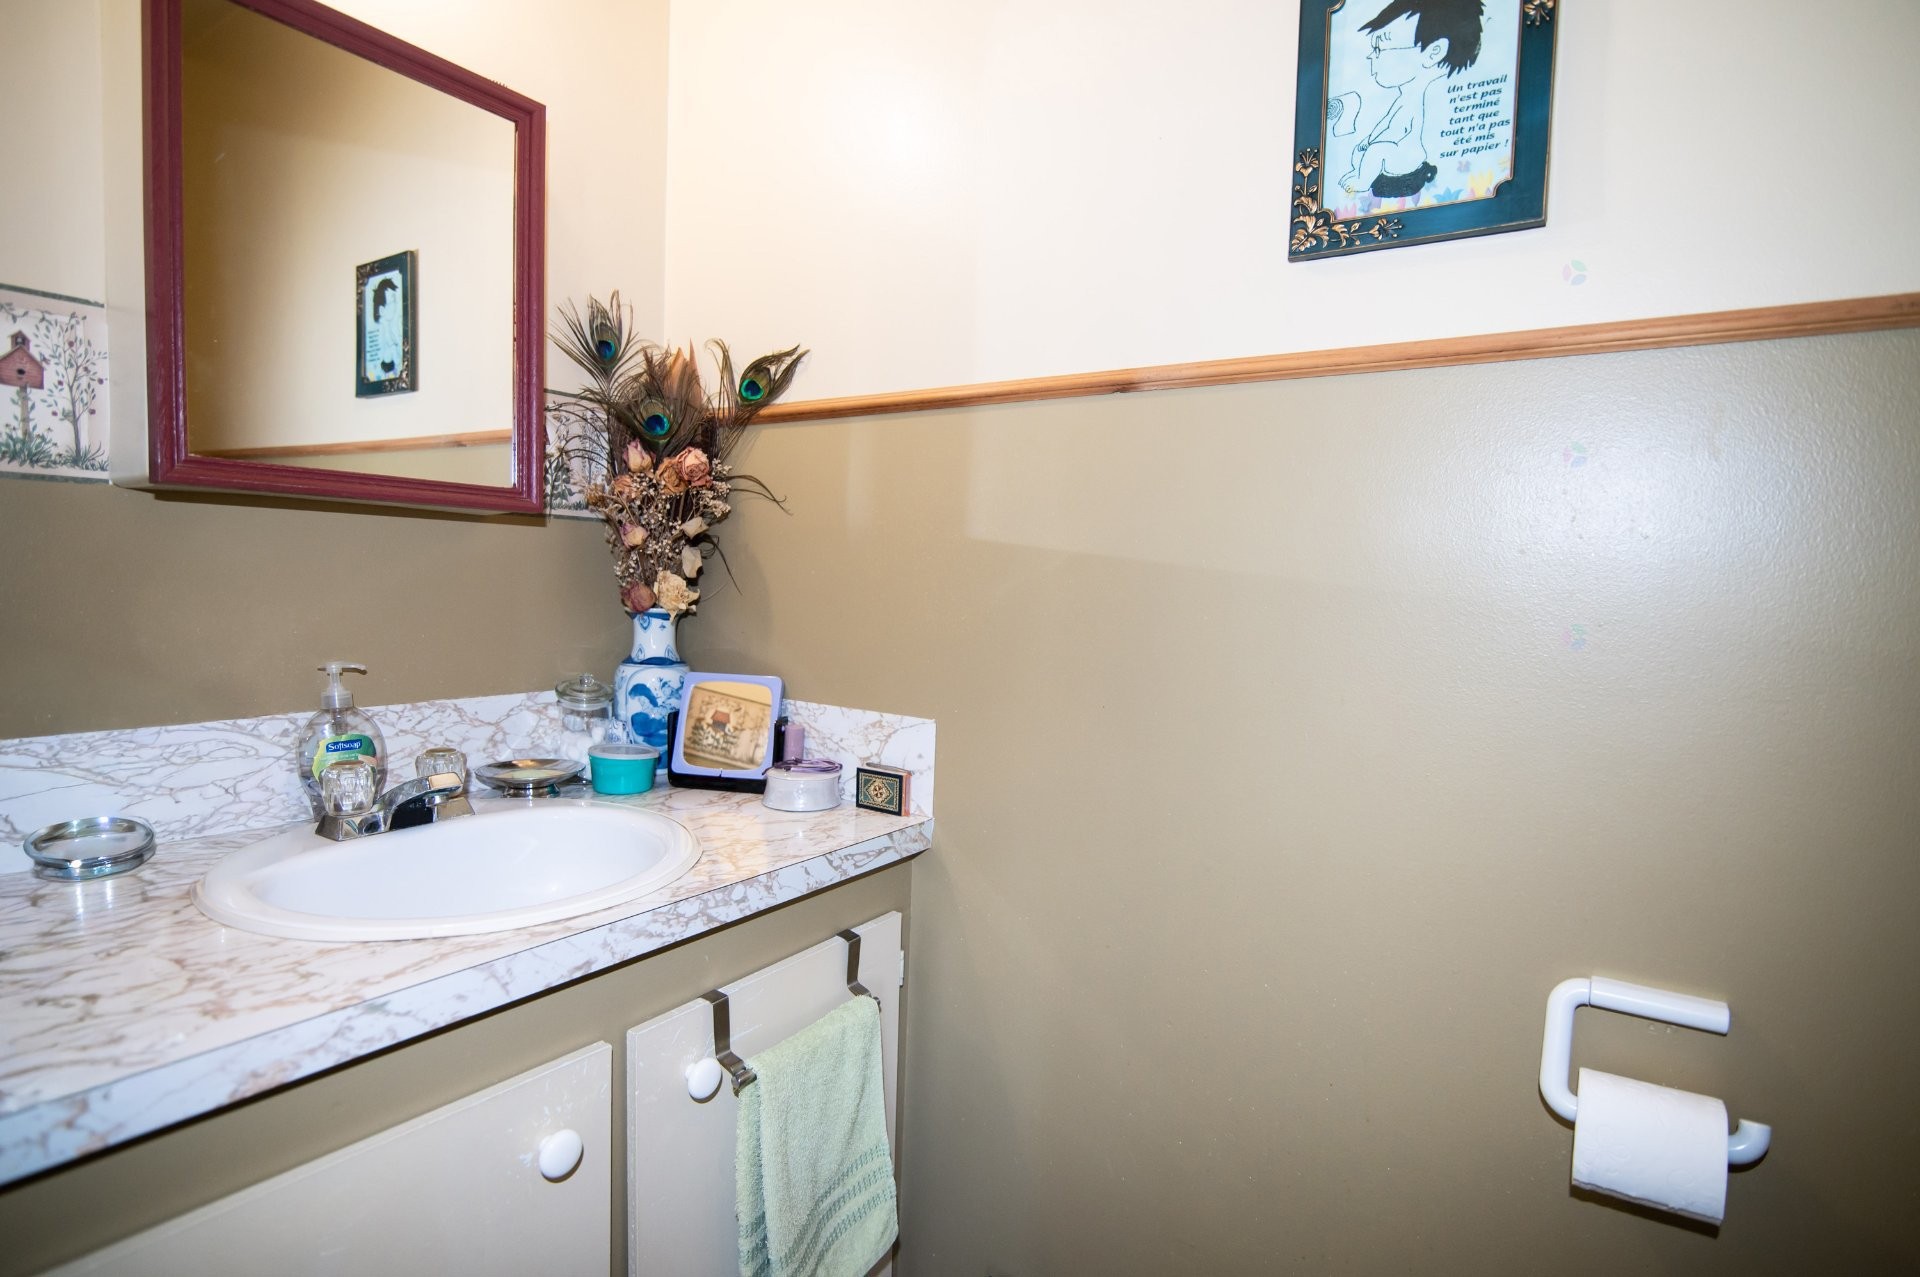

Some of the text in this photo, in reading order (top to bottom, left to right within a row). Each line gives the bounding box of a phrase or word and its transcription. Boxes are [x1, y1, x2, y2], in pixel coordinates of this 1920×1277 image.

[1447, 74, 1508, 94] Un travail
[1449, 88, 1502, 104] n'est pas
[1453, 97, 1500, 114] terminé
[1449, 110, 1500, 125] tant que
[1440, 118, 1511, 138] tout n'a pas
[1453, 131, 1495, 146] été mis
[1439, 138, 1509, 159] sur papier !
[328, 741, 361, 751] Softsoap
